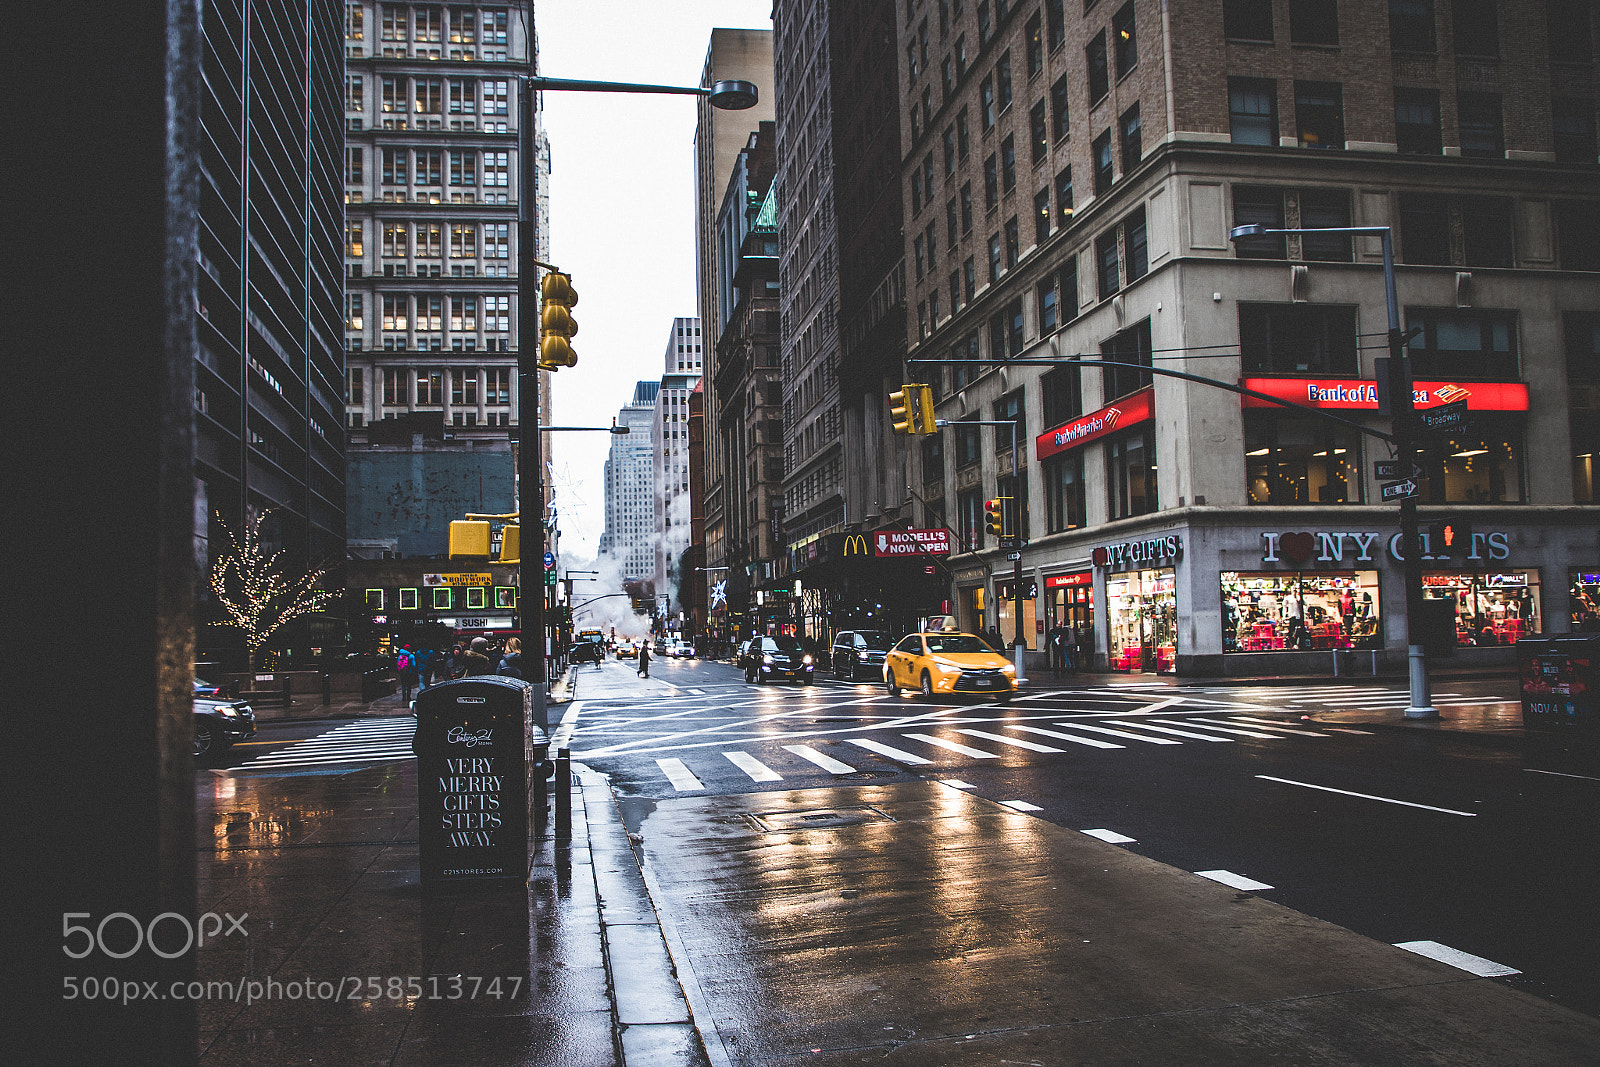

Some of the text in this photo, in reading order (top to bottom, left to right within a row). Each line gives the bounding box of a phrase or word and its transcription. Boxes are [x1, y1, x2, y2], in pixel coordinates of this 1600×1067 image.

[1307, 384, 1348, 402] Bank
[1348, 385, 1365, 402] of
[1427, 411, 1461, 426] Broadway
[1054, 428, 1071, 447] Bank
[1076, 417, 1103, 439] America
[1385, 482, 1414, 496] ONE WAY
[891, 531, 946, 543] MODELL'S
[889, 542, 949, 554] NOW OPEN
[1105, 543, 1126, 566] NY
[1130, 535, 1177, 563] GIFTS
[1263, 531, 1280, 563] I
[1316, 531, 1379, 562] NY
[462, 618, 488, 627] SUSHI
[1530, 702, 1550, 714] NOV
[1552, 703, 1559, 714] 4
[447, 726, 494, 748] Century 21
[446, 757, 495, 774] VERY
[439, 775, 504, 793] MERRY
[443, 793, 500, 811] GIFTS
[442, 812, 502, 829] STEPS
[446, 830, 496, 848] AWAY.
